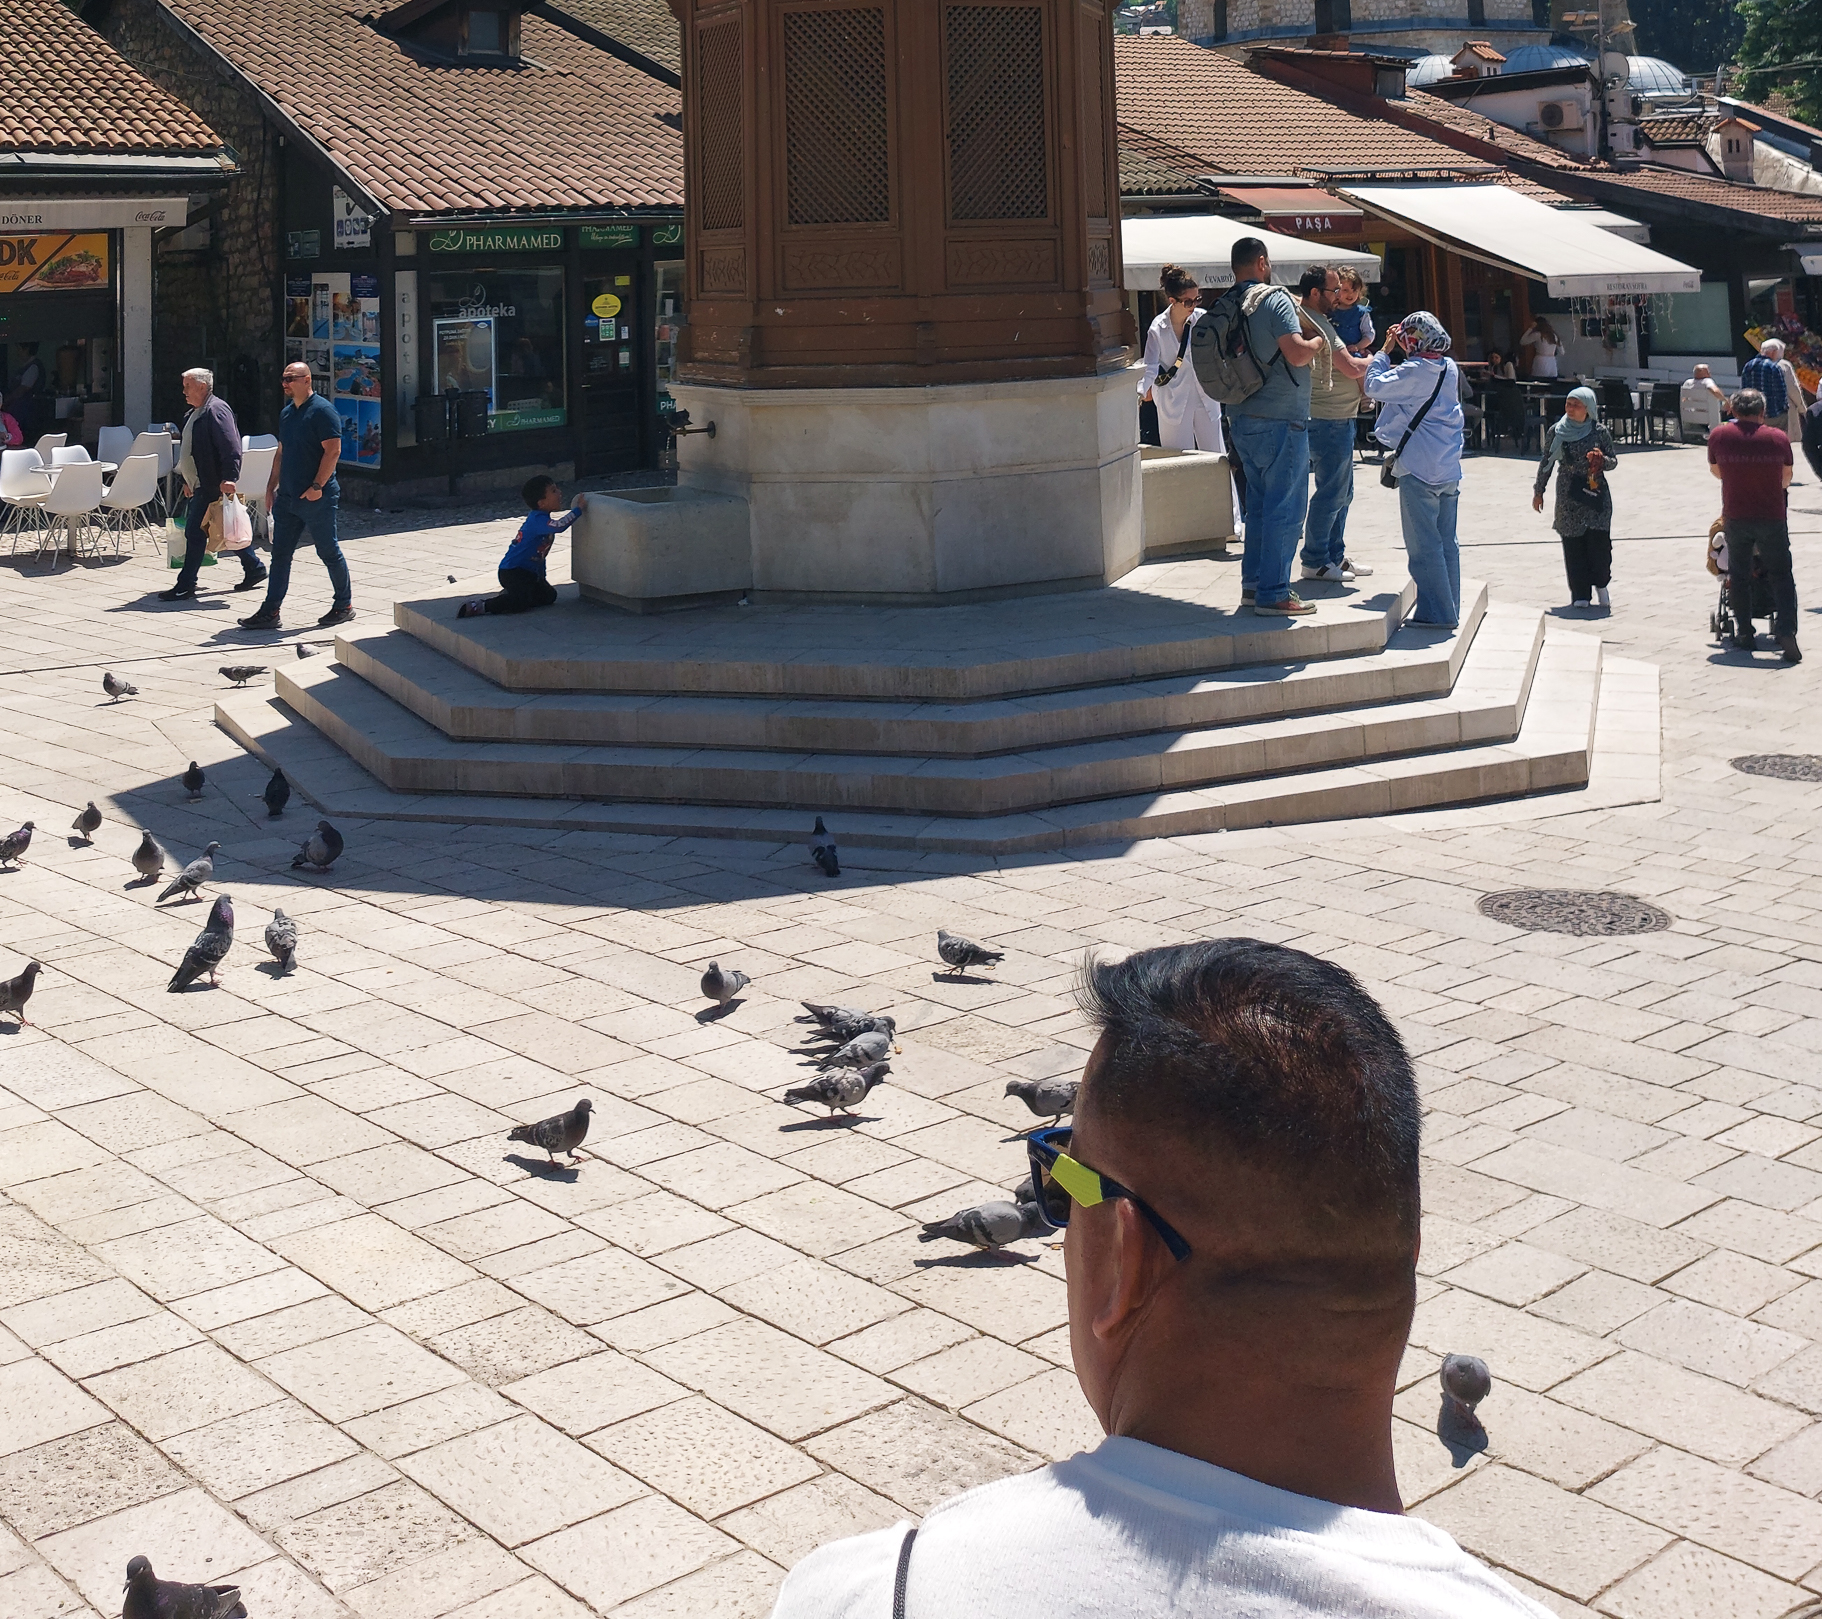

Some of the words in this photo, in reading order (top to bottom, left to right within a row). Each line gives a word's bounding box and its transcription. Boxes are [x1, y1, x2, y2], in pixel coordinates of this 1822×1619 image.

[2, 214, 43, 224] DÖNER
[1296, 217, 1332, 232] PAŞA
[466, 235, 561, 250] PHARMAMED
[459, 303, 516, 319] apoteka
